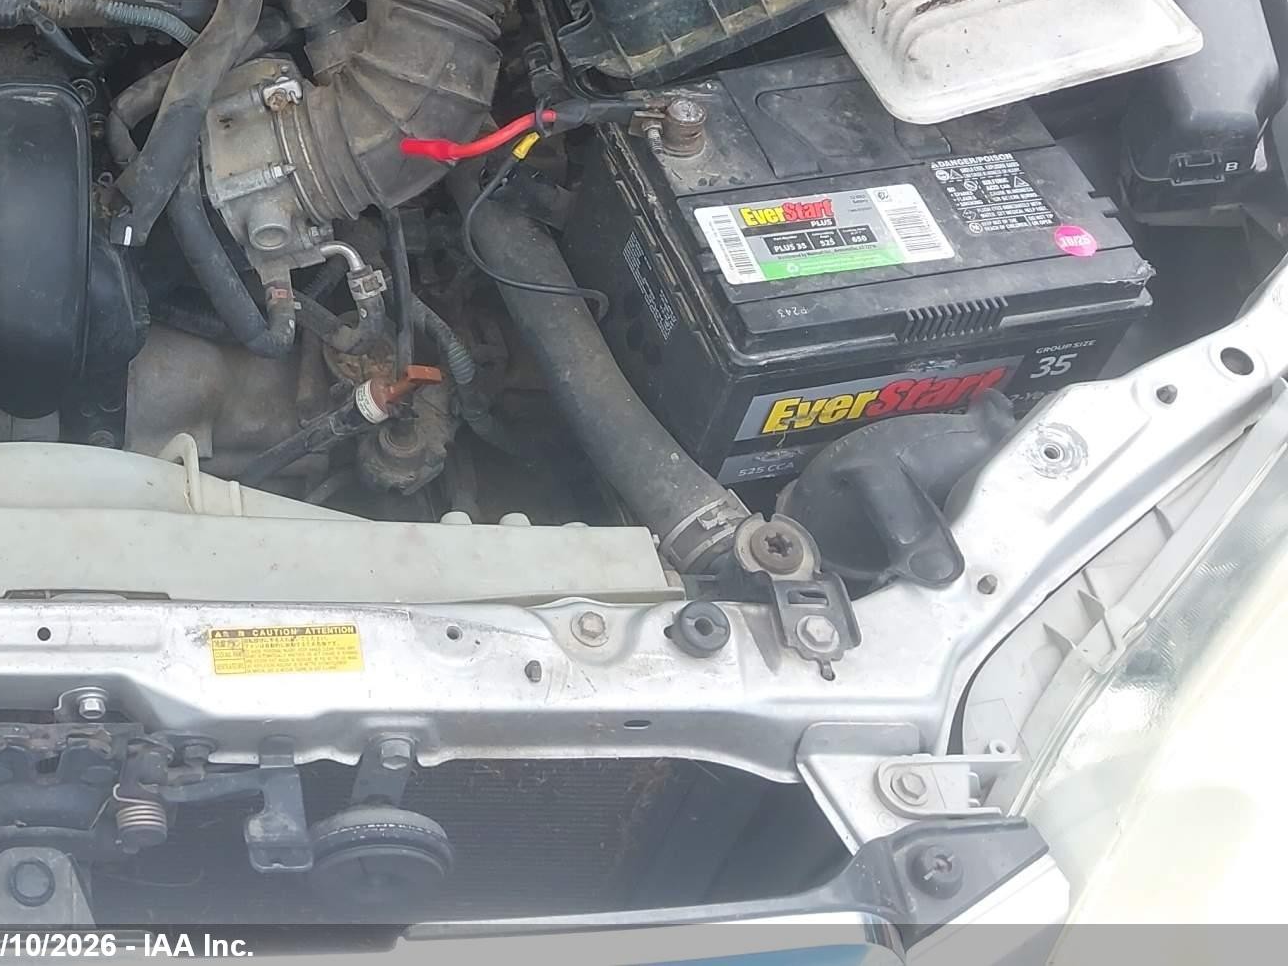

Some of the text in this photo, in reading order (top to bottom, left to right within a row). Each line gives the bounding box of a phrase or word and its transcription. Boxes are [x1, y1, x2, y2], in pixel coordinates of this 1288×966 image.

[740, 199, 834, 226] EverStart
[810, 218, 833, 228] PLUS
[773, 243, 796, 253] PLUS
[1035, 339, 1096, 355] GROUP SIZE
[1029, 353, 1078, 379] 35
[762, 366, 1008, 434] EverStart
[737, 461, 794, 477] 525 CCA
[253, 627, 298, 637] CAUTION
[304, 626, 354, 635] ATTENTION
